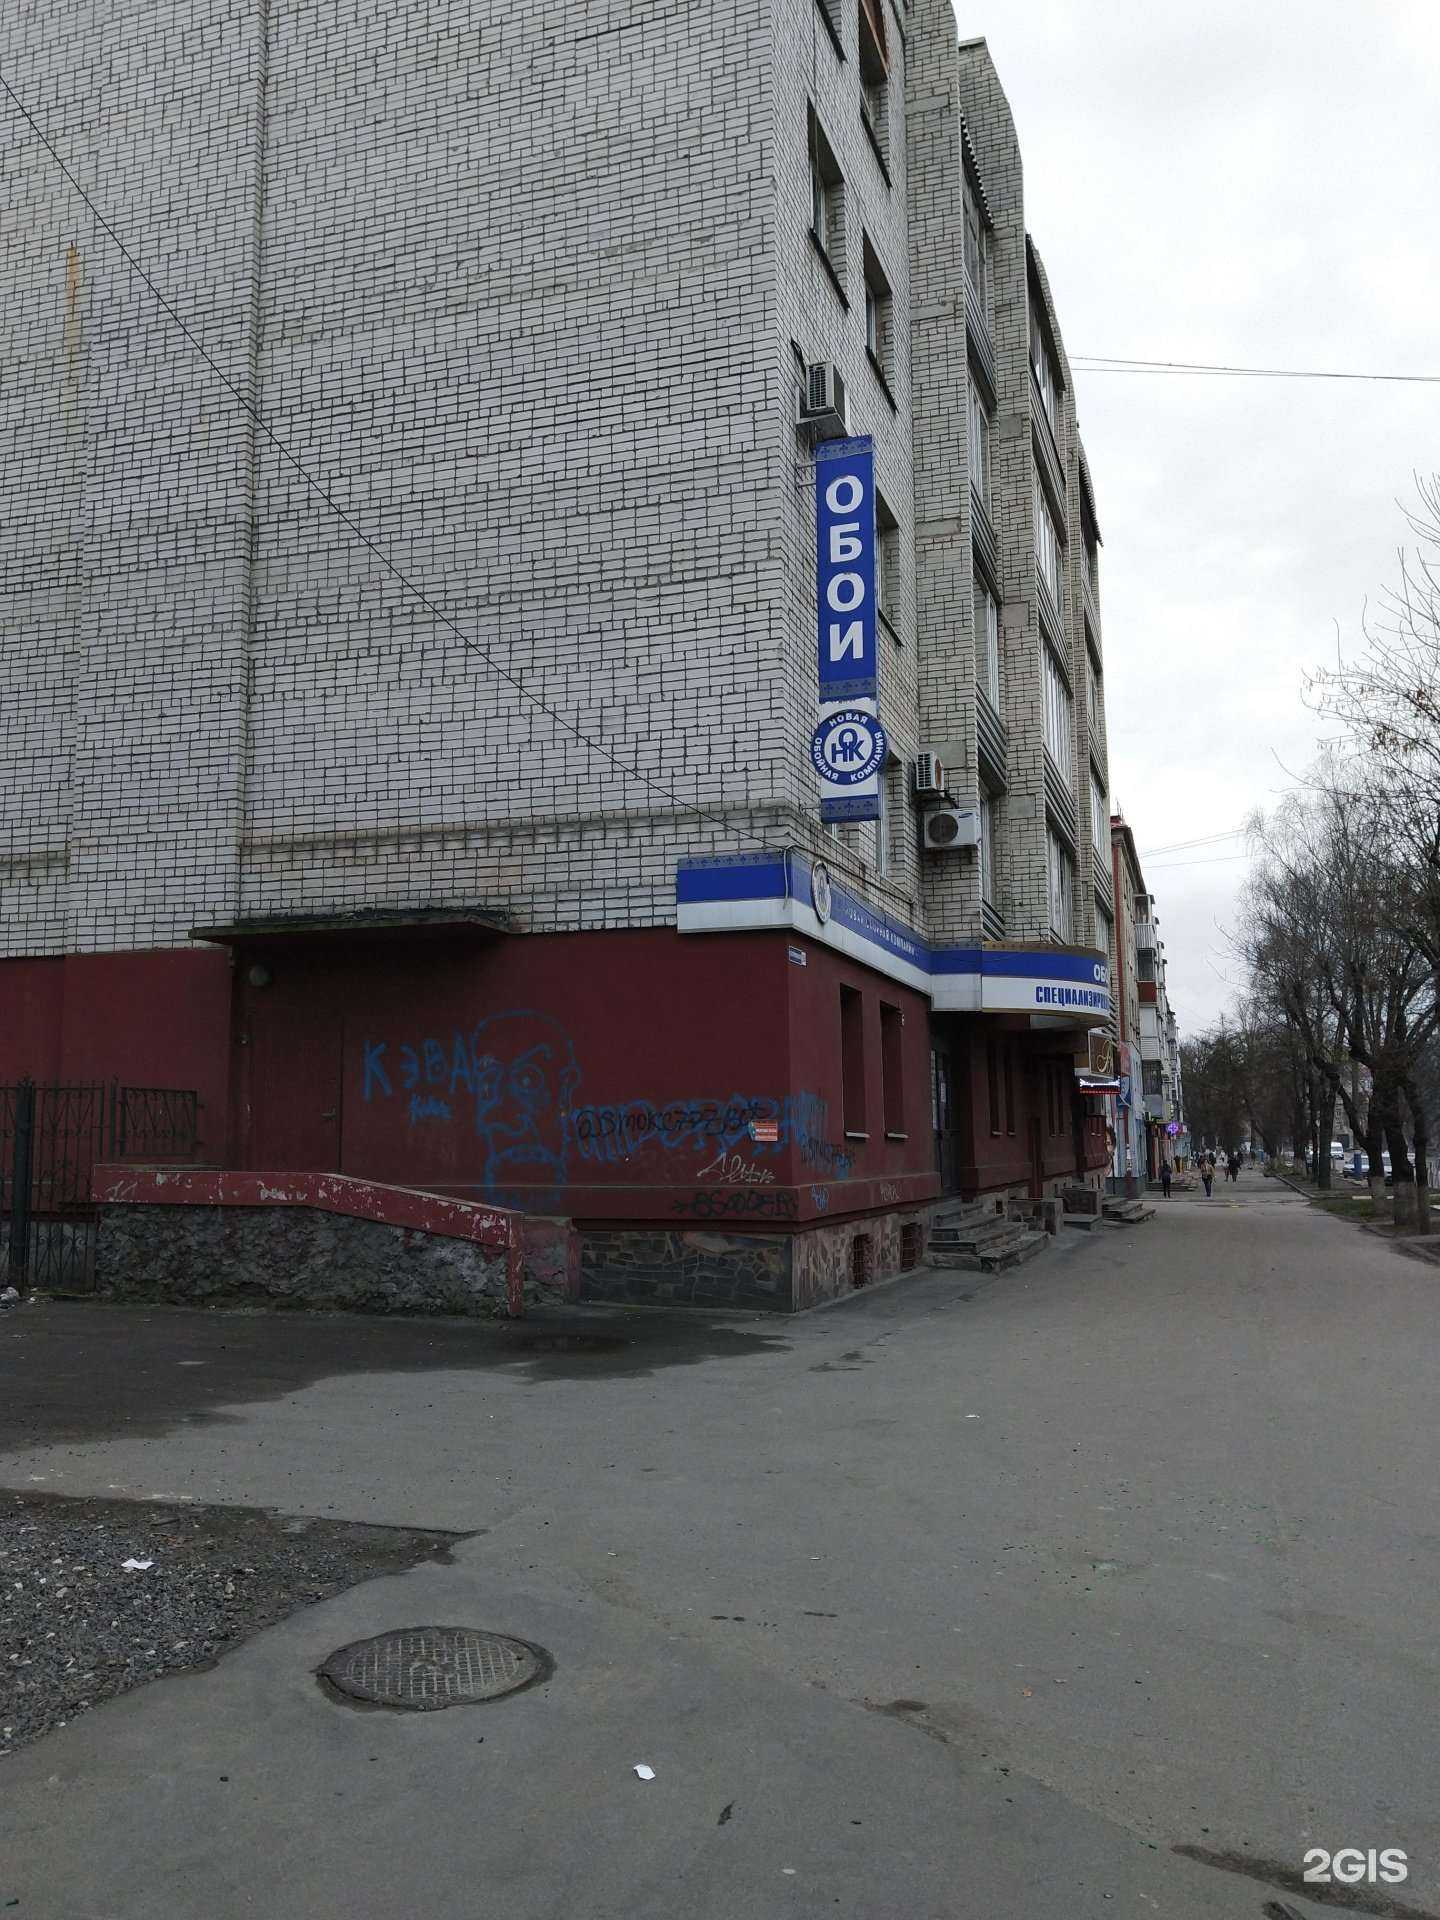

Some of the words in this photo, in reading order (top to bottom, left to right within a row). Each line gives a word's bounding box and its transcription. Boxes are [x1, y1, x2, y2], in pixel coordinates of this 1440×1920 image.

[825, 474, 866, 663] ОБОИ
[828, 712, 868, 727] НОВАЯ
[813, 737, 839, 781] ОБОЙНАЯ
[850, 731, 884, 782] КОМПАНИЯ
